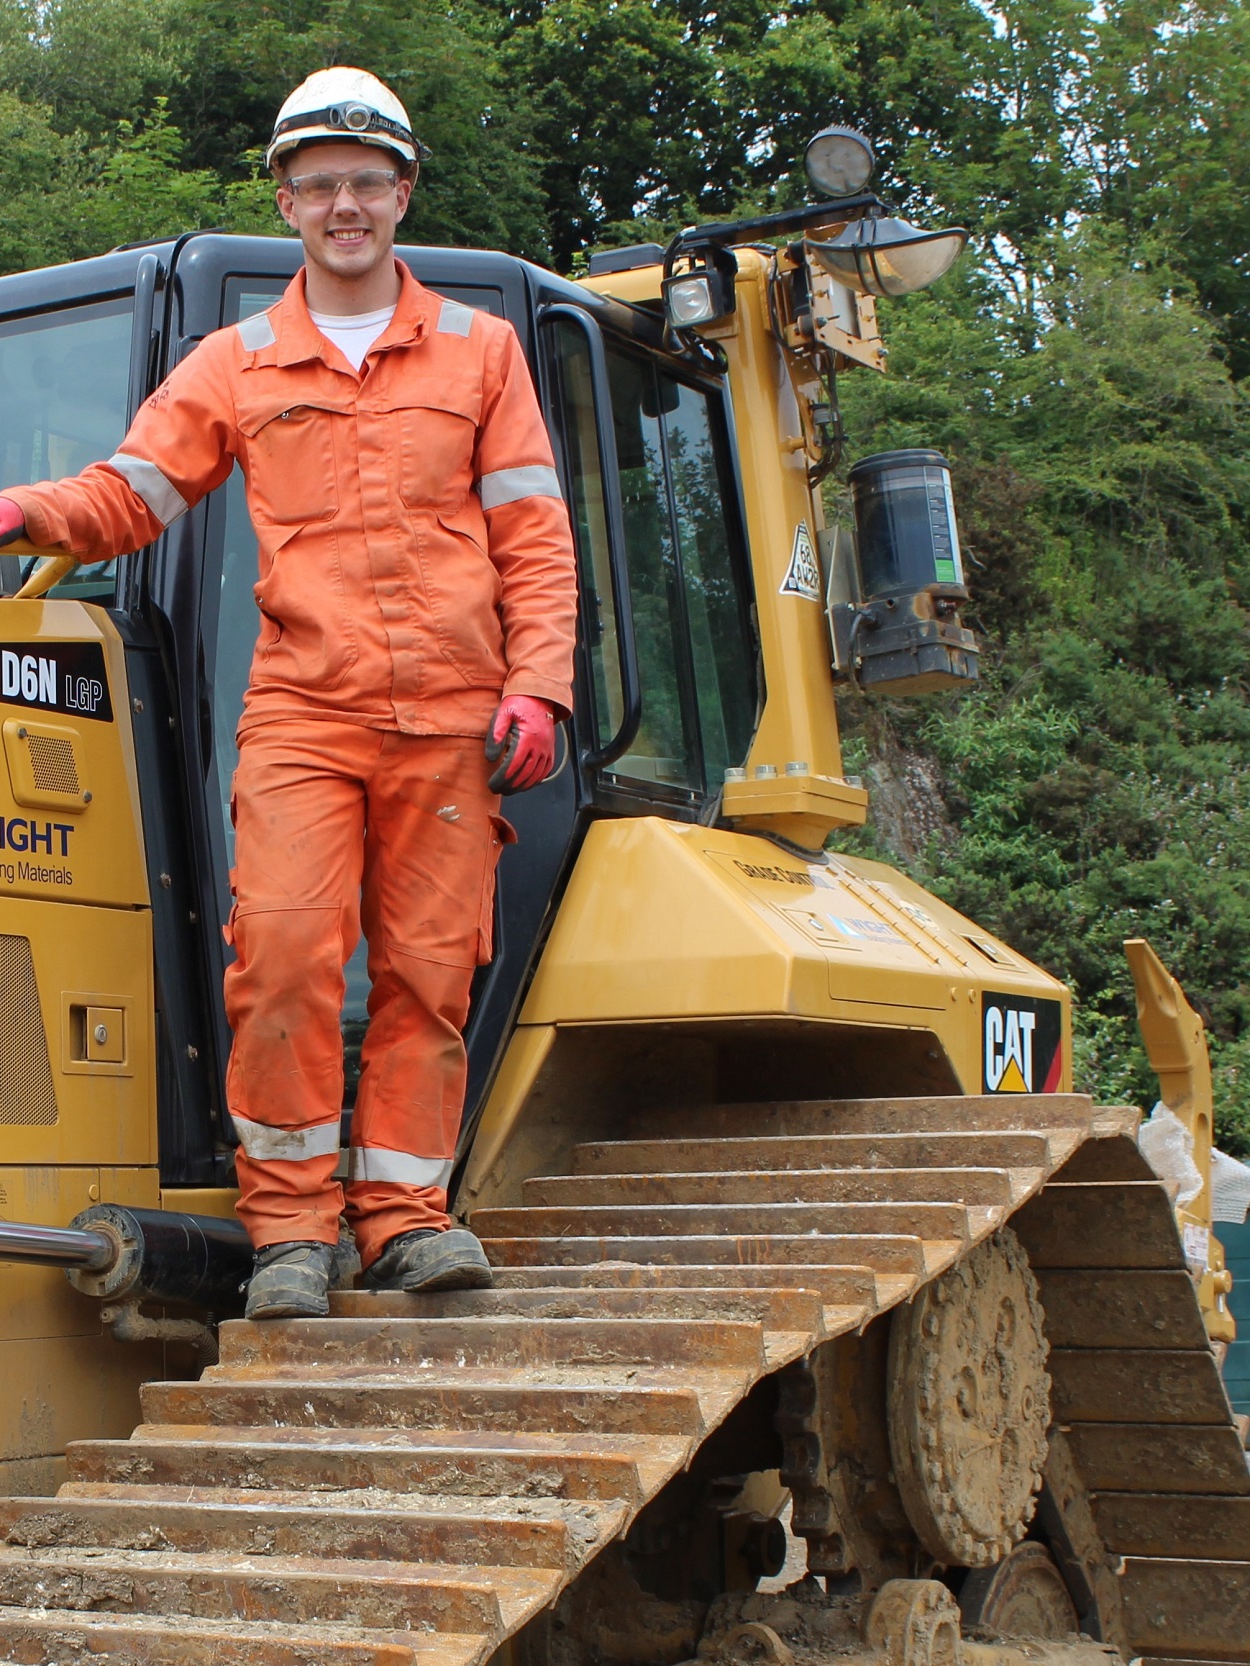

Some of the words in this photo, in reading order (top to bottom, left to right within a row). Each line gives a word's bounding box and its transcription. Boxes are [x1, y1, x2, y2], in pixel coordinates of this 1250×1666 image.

[2, 649, 57, 705] D6N
[65, 674, 103, 712] LGP
[17, 861, 73, 885] Materials
[985, 1005, 1037, 1094] CAT
